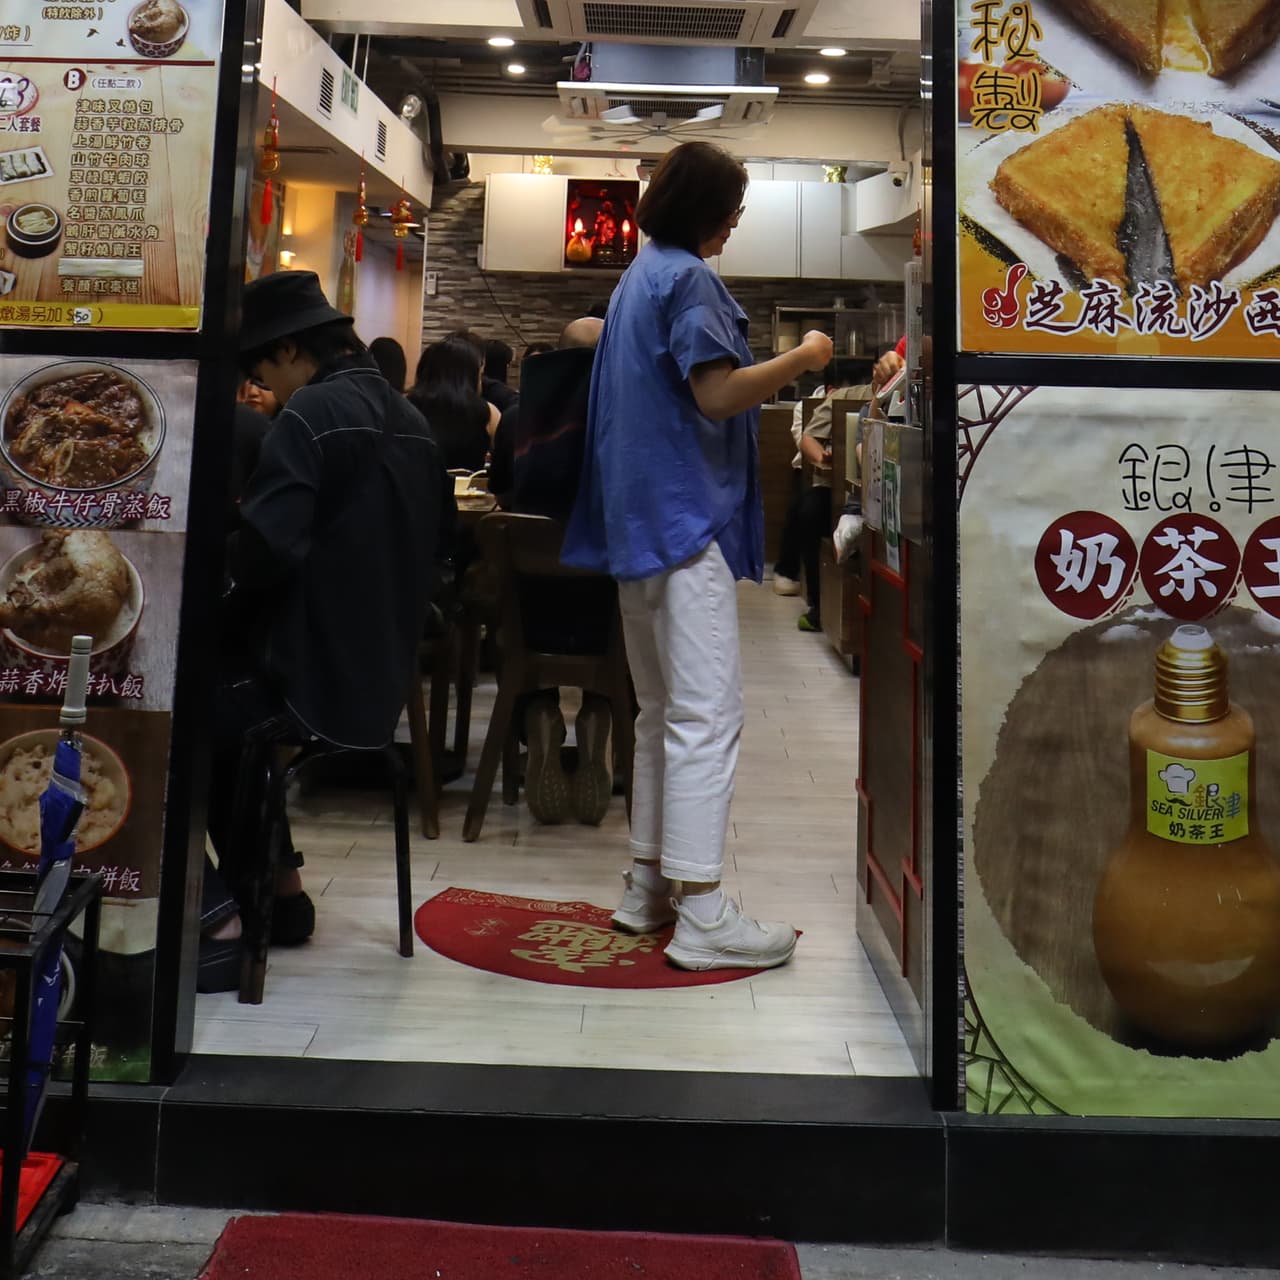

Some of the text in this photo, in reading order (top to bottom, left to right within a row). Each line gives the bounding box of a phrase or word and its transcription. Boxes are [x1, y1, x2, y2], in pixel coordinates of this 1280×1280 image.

[67, 70, 81, 89] B
[72, 133, 152, 150] 上湯鮮竹卷
[70, 151, 150, 168] 山竹牛肉球
[1118, 442, 1277, 514] 銀津
[1151, 799, 1225, 821] SEA SILVER
[1168, 820, 1225, 840] 奶茶王
